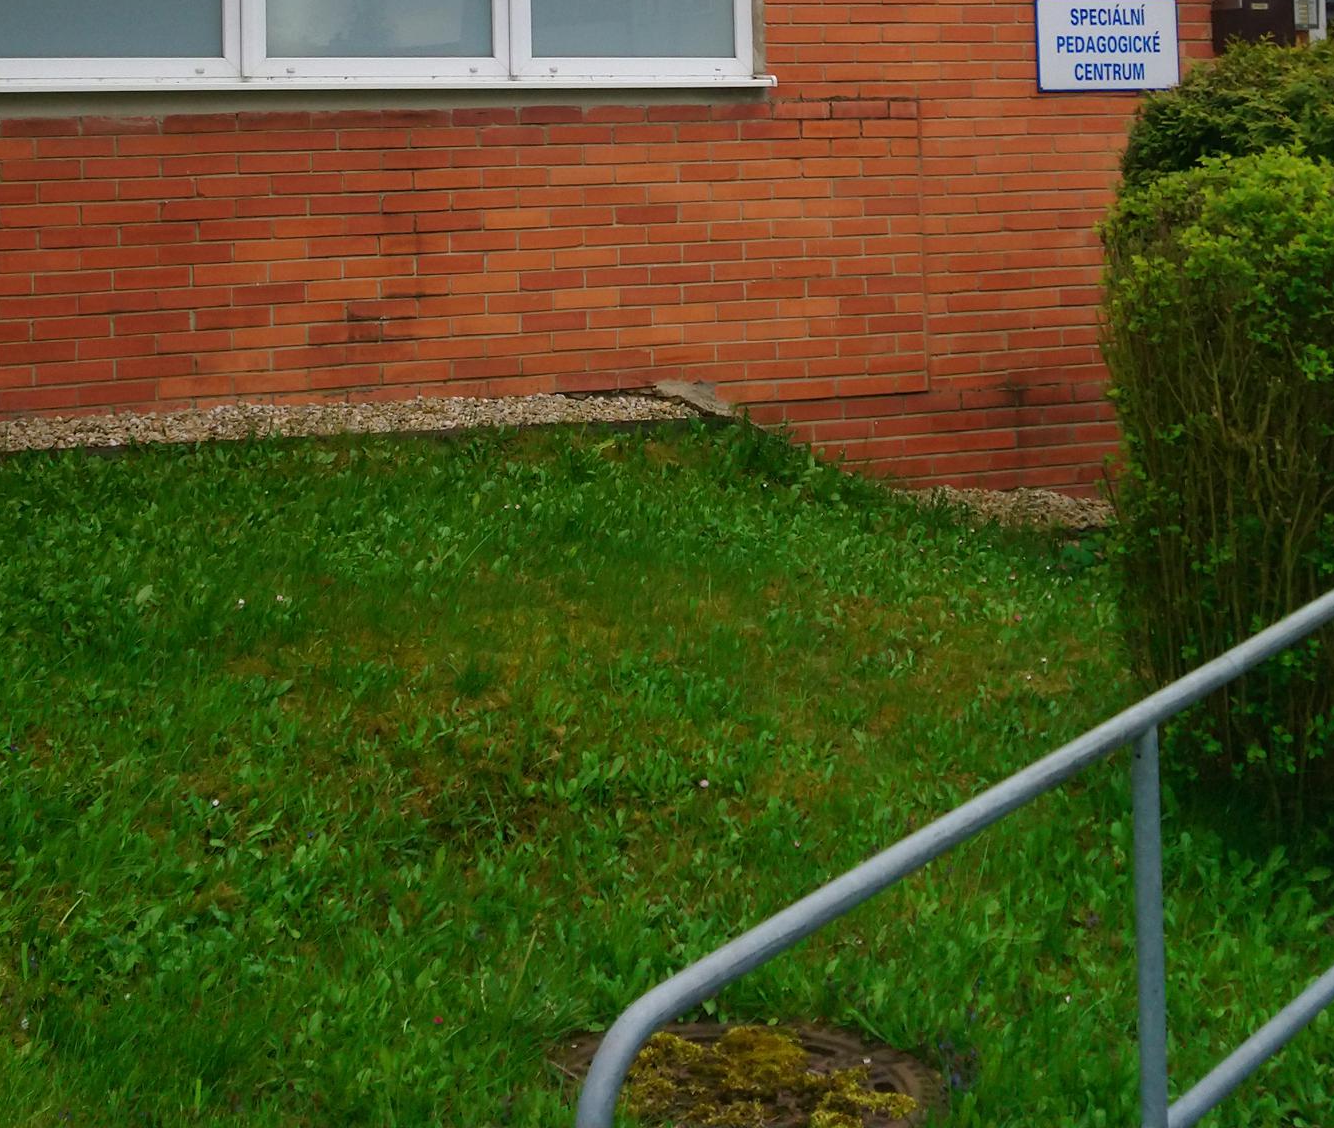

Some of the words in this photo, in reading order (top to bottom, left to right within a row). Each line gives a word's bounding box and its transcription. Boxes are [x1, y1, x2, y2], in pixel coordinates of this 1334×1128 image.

[1070, 4, 1145, 25] SPECIÁLNÍ
[1056, 31, 1161, 53] PEDAGOGICKÉ
[1074, 63, 1145, 81] CENTRUM
